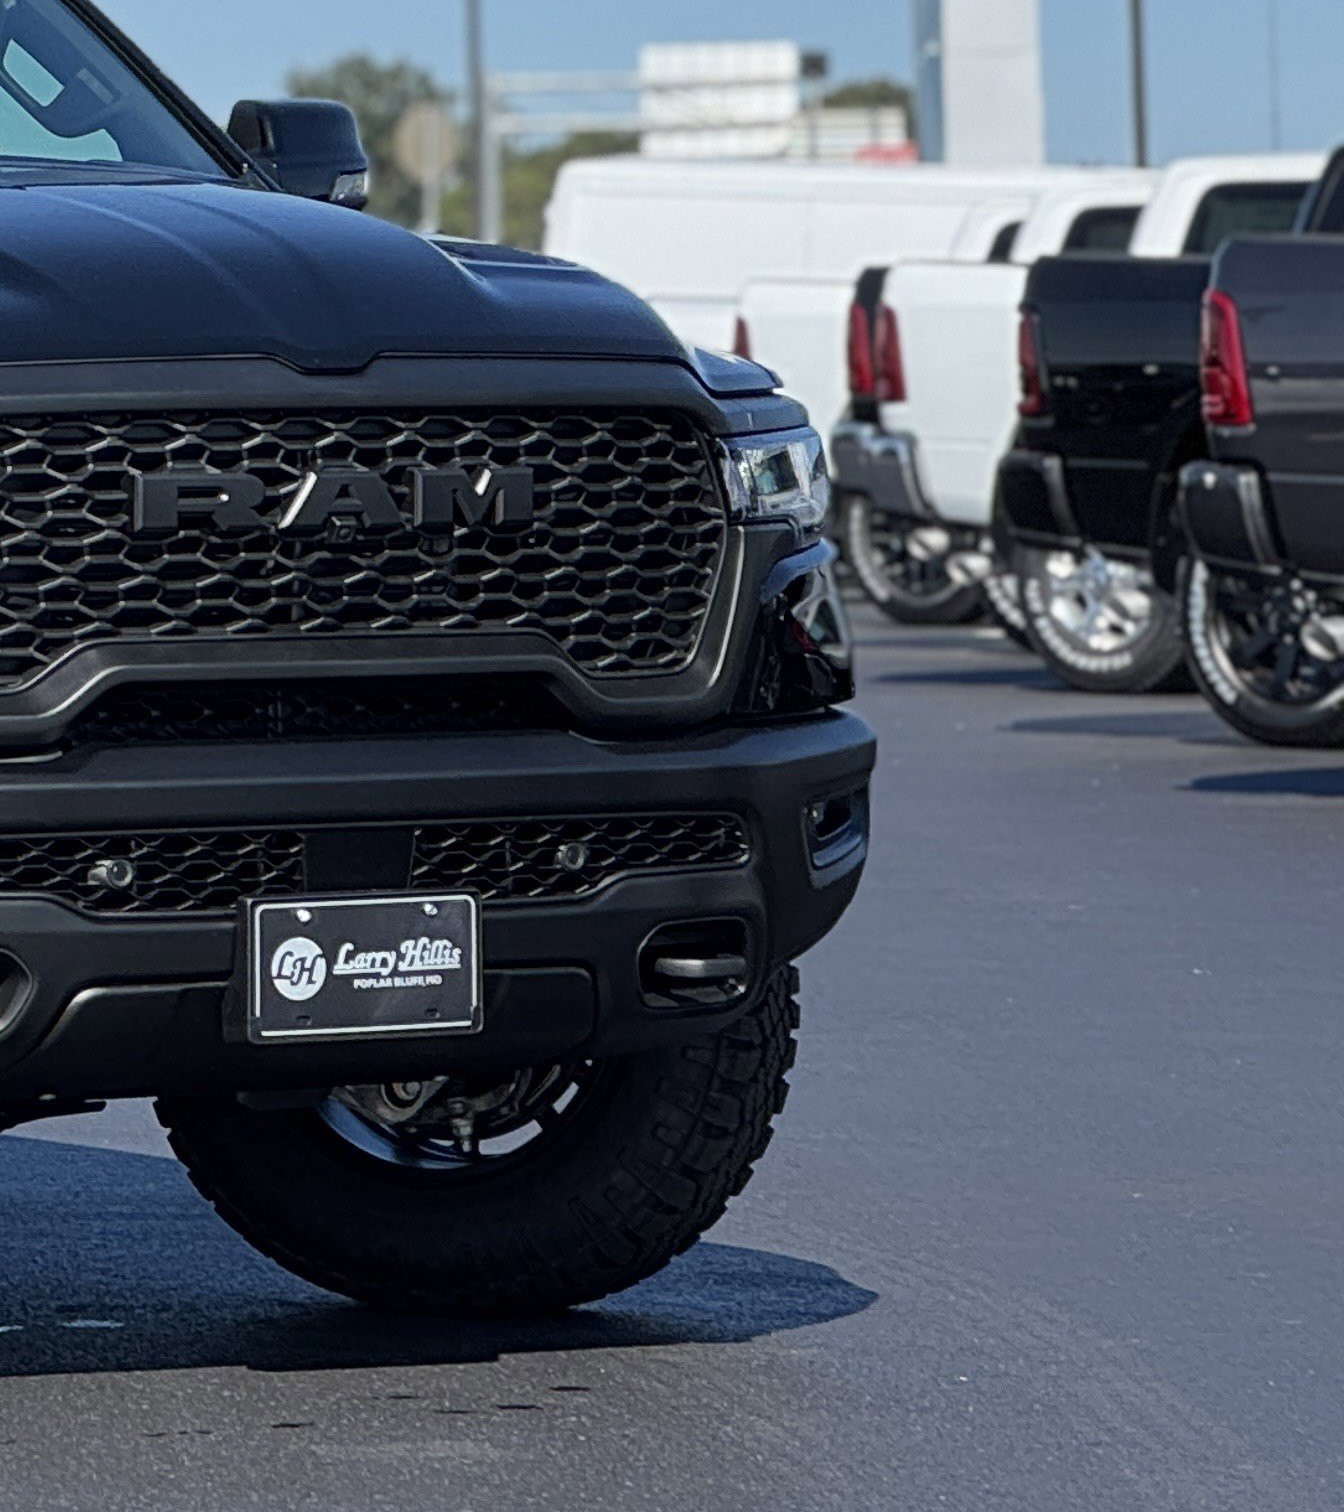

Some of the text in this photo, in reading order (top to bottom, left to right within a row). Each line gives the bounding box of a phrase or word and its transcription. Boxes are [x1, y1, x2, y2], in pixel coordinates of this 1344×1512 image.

[128, 468, 534, 533] RAM
[332, 937, 462, 975] Larry Hillis
